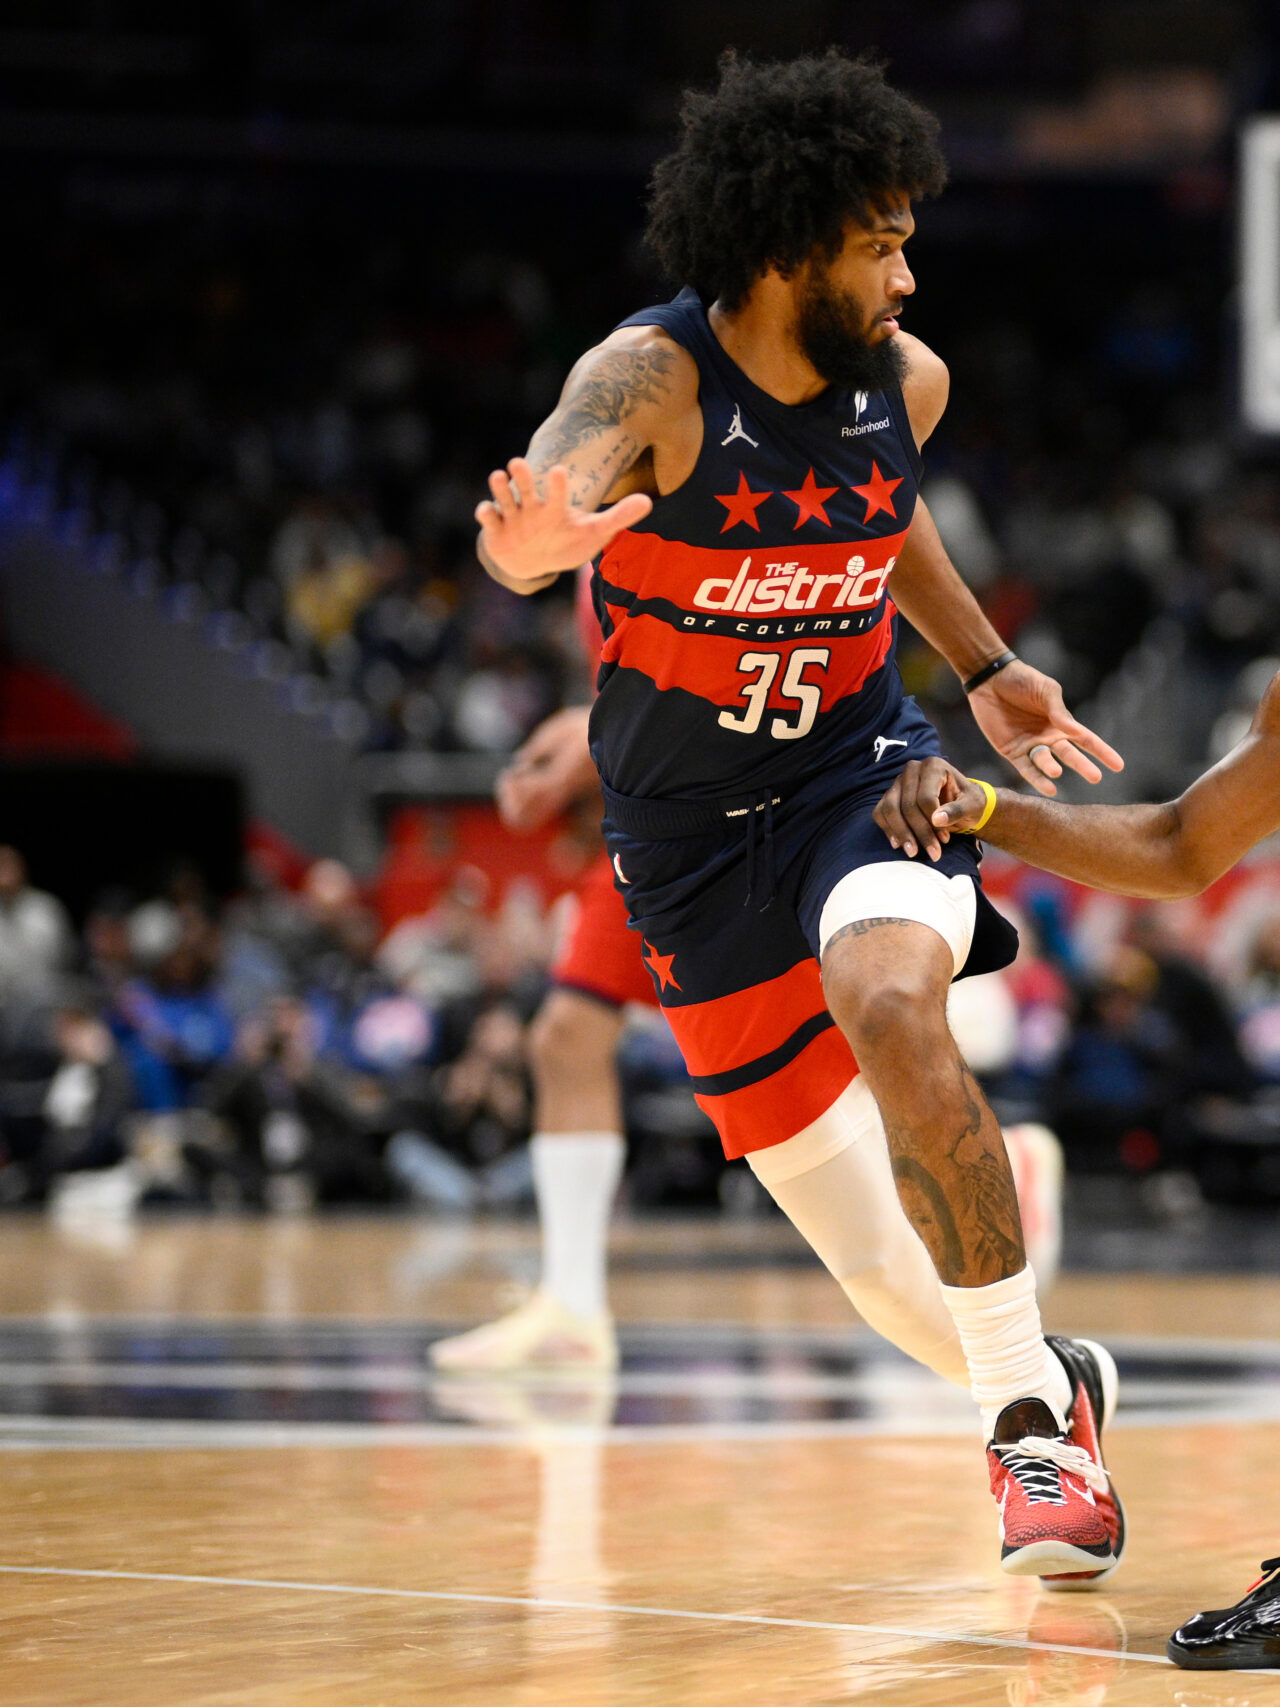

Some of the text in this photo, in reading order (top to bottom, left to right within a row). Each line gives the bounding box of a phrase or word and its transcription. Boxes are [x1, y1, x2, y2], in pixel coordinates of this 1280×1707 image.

[841, 416, 890, 437] Robinhood
[765, 562, 799, 577] THE
[693, 556, 896, 612] district
[683, 616, 872, 635] OF COLUMBI
[717, 647, 831, 740] 35
